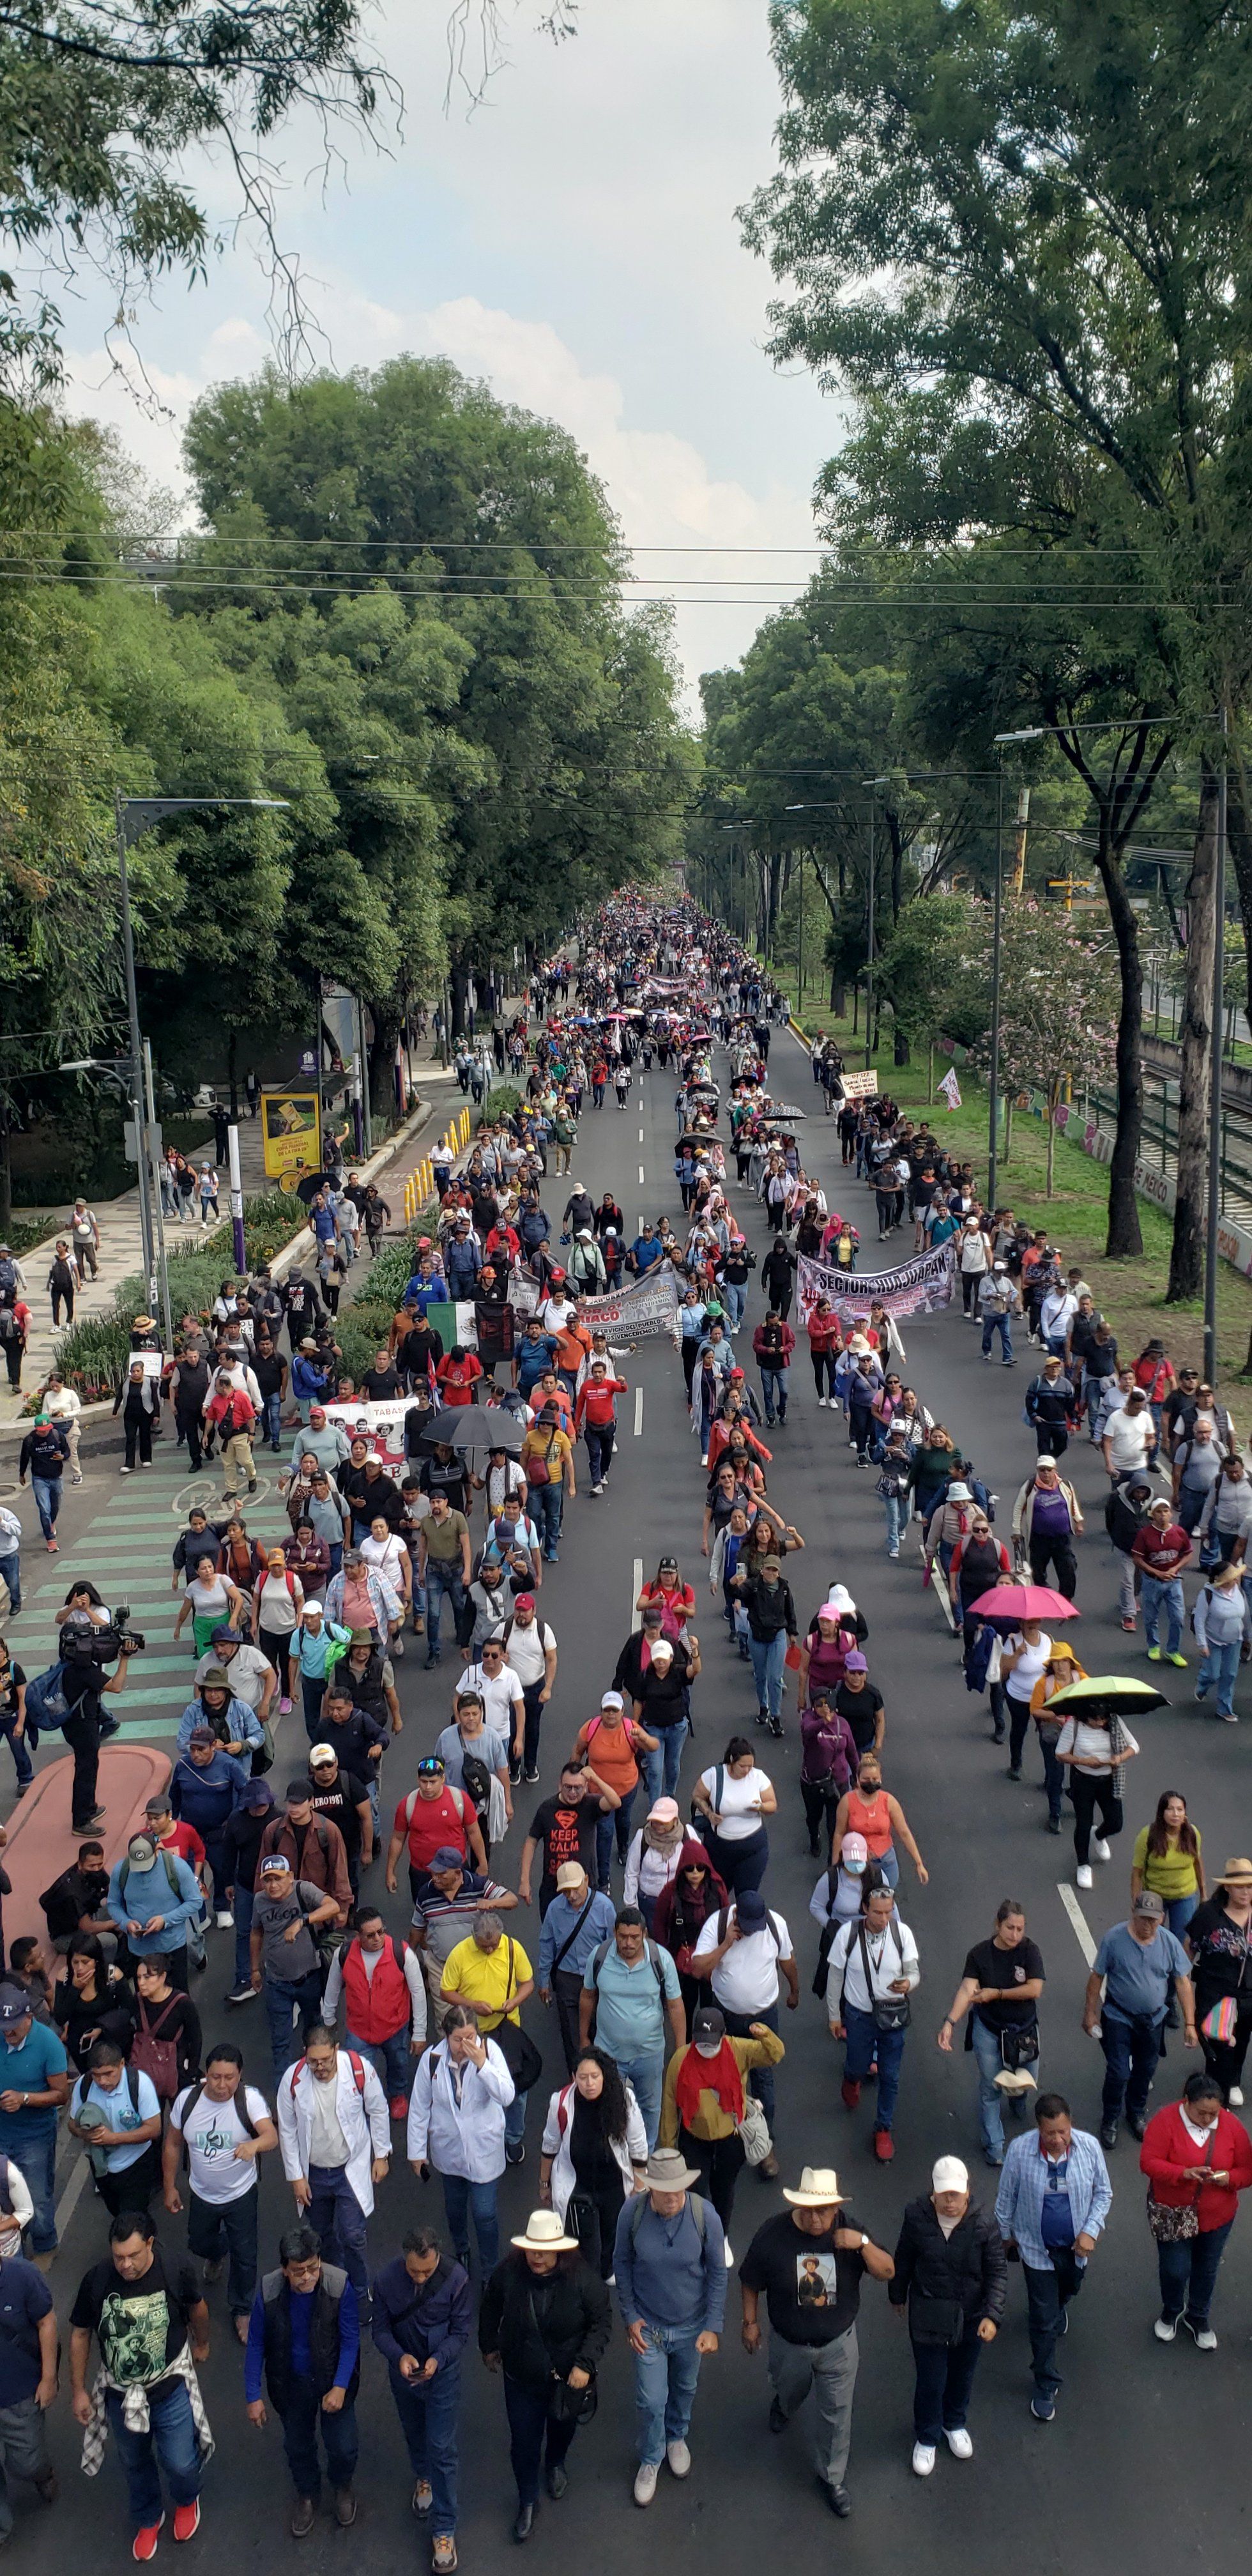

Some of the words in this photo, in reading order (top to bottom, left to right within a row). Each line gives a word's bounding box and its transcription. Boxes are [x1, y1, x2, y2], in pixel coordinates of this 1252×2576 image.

[819, 1273, 869, 1294] SECTOR
[874, 1253, 948, 1294] HUAJUAPAN
[551, 1829, 578, 1841] KEEP
[550, 1841, 579, 1852] CALM
[3, 2005, 13, 2017] T
